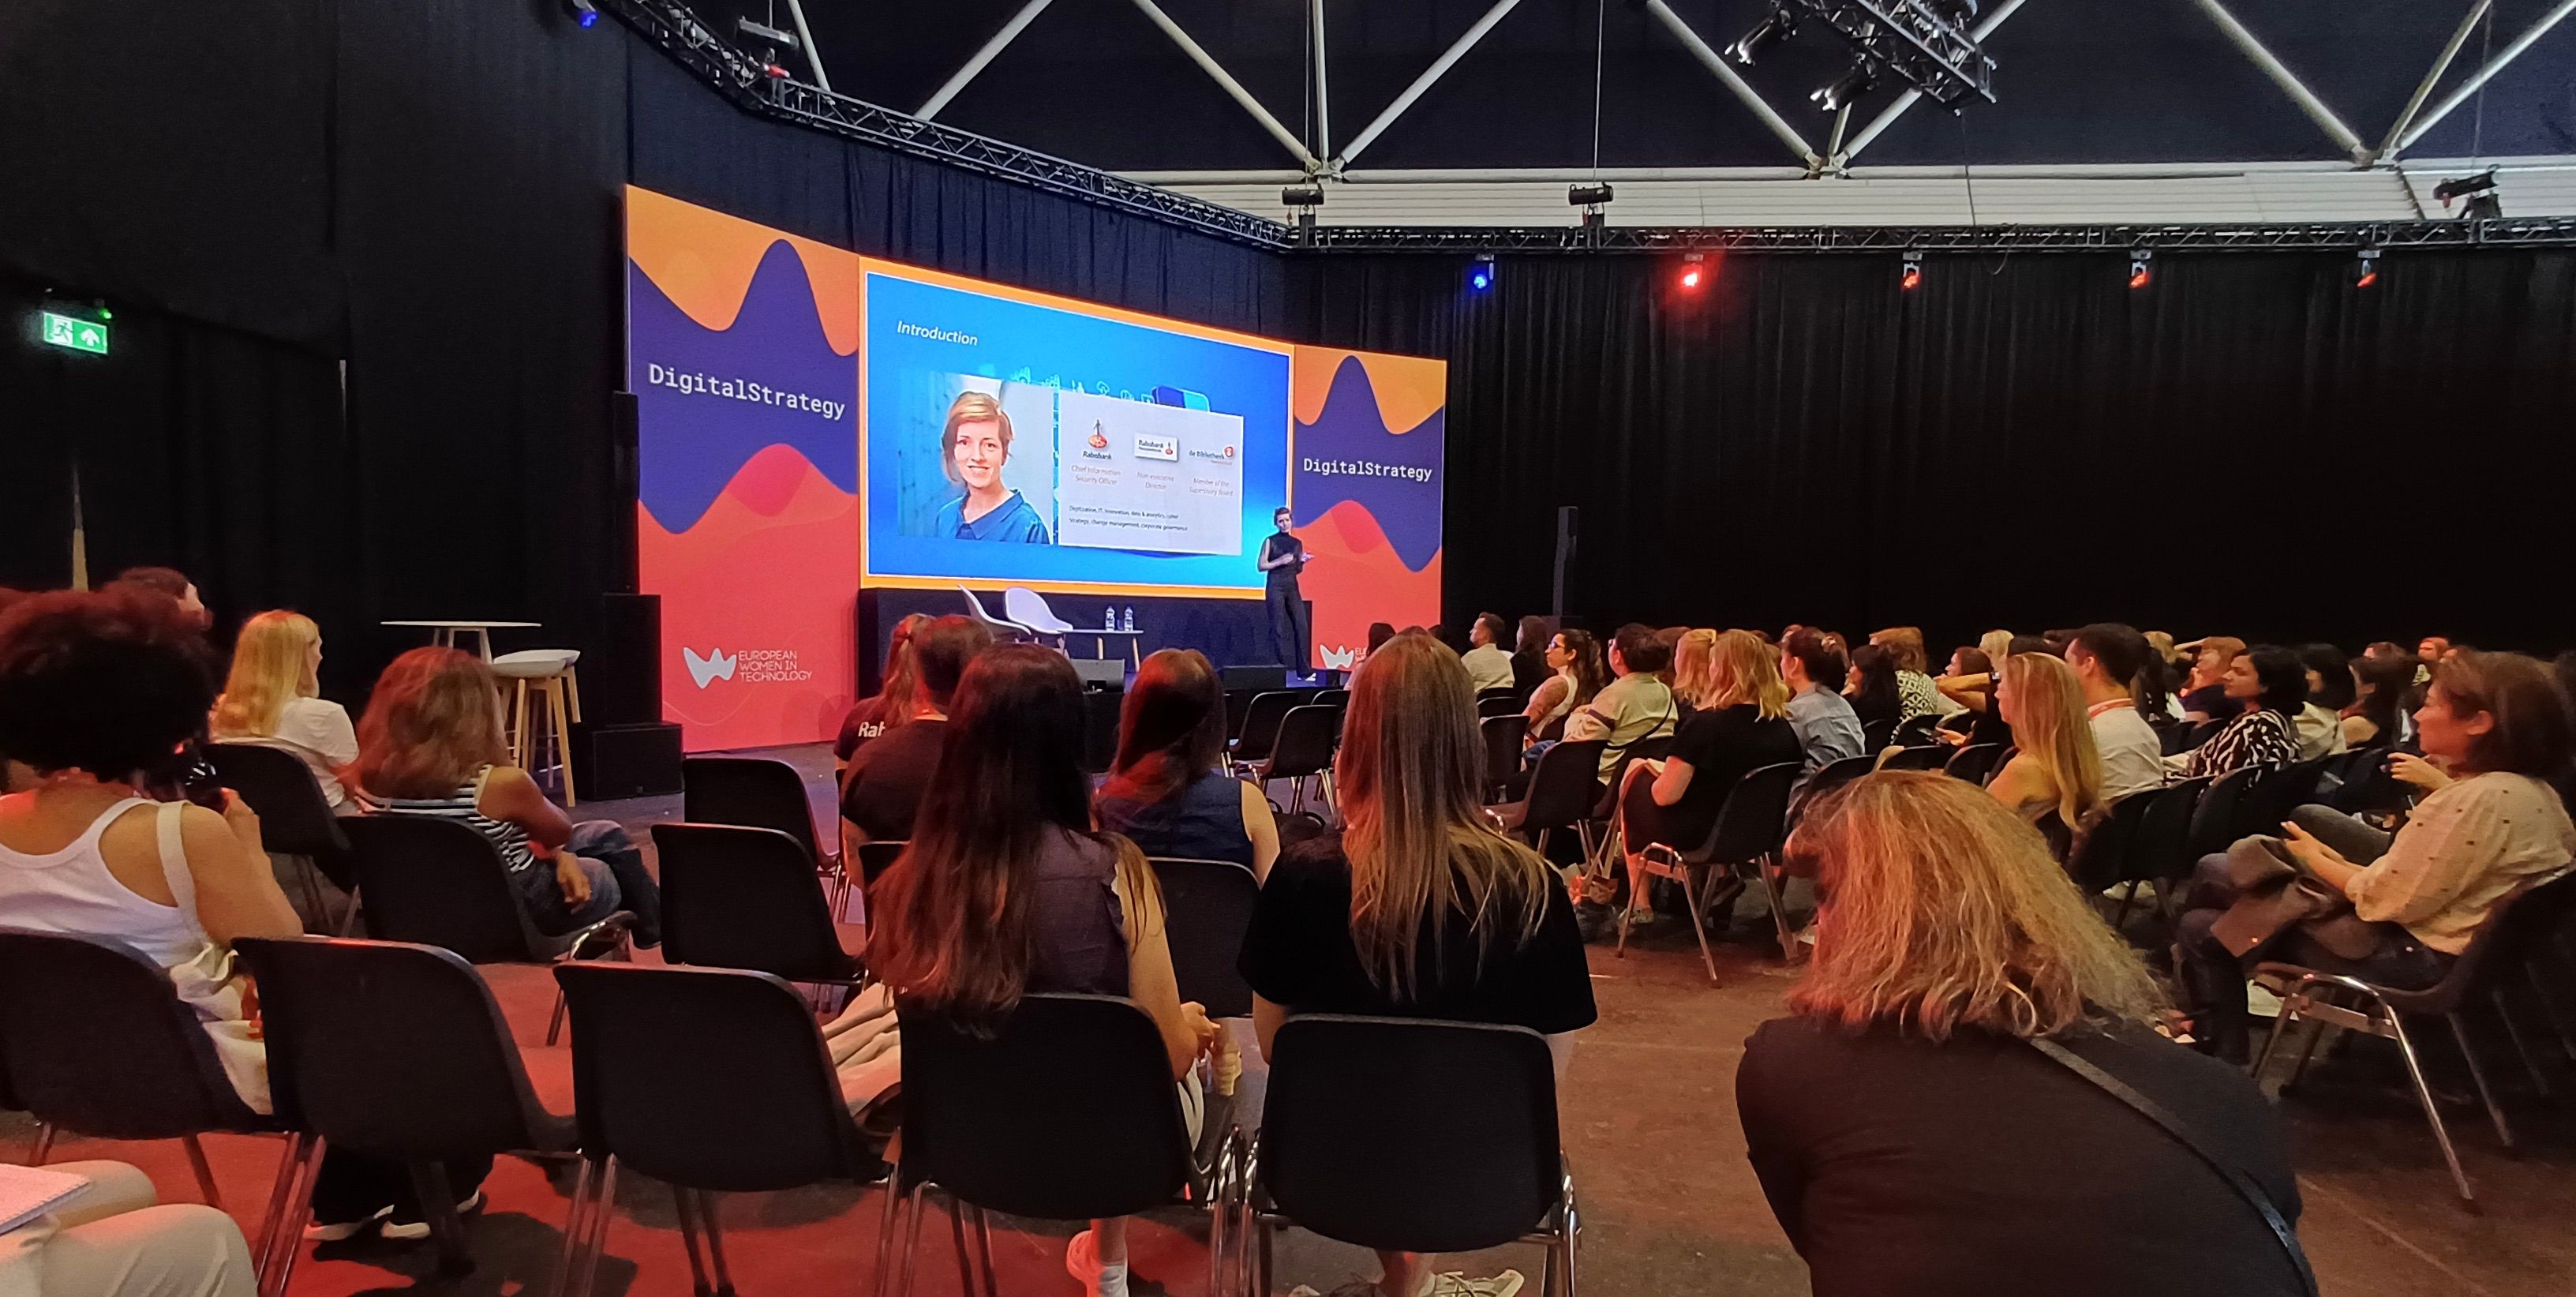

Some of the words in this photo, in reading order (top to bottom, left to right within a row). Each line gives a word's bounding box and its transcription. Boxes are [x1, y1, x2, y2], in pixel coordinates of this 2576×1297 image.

[897, 321, 978, 346] Introduction
[649, 363, 845, 421] DigitalStrategy
[1083, 451, 1111, 459] Rabobank
[1304, 458, 1432, 482] DigitalStrategy
[739, 650, 797, 662] EUROPEAN
[739, 661, 782, 671] WOMEN
[785, 661, 797, 670] IN
[740, 671, 812, 682] TECHNOLOGY
